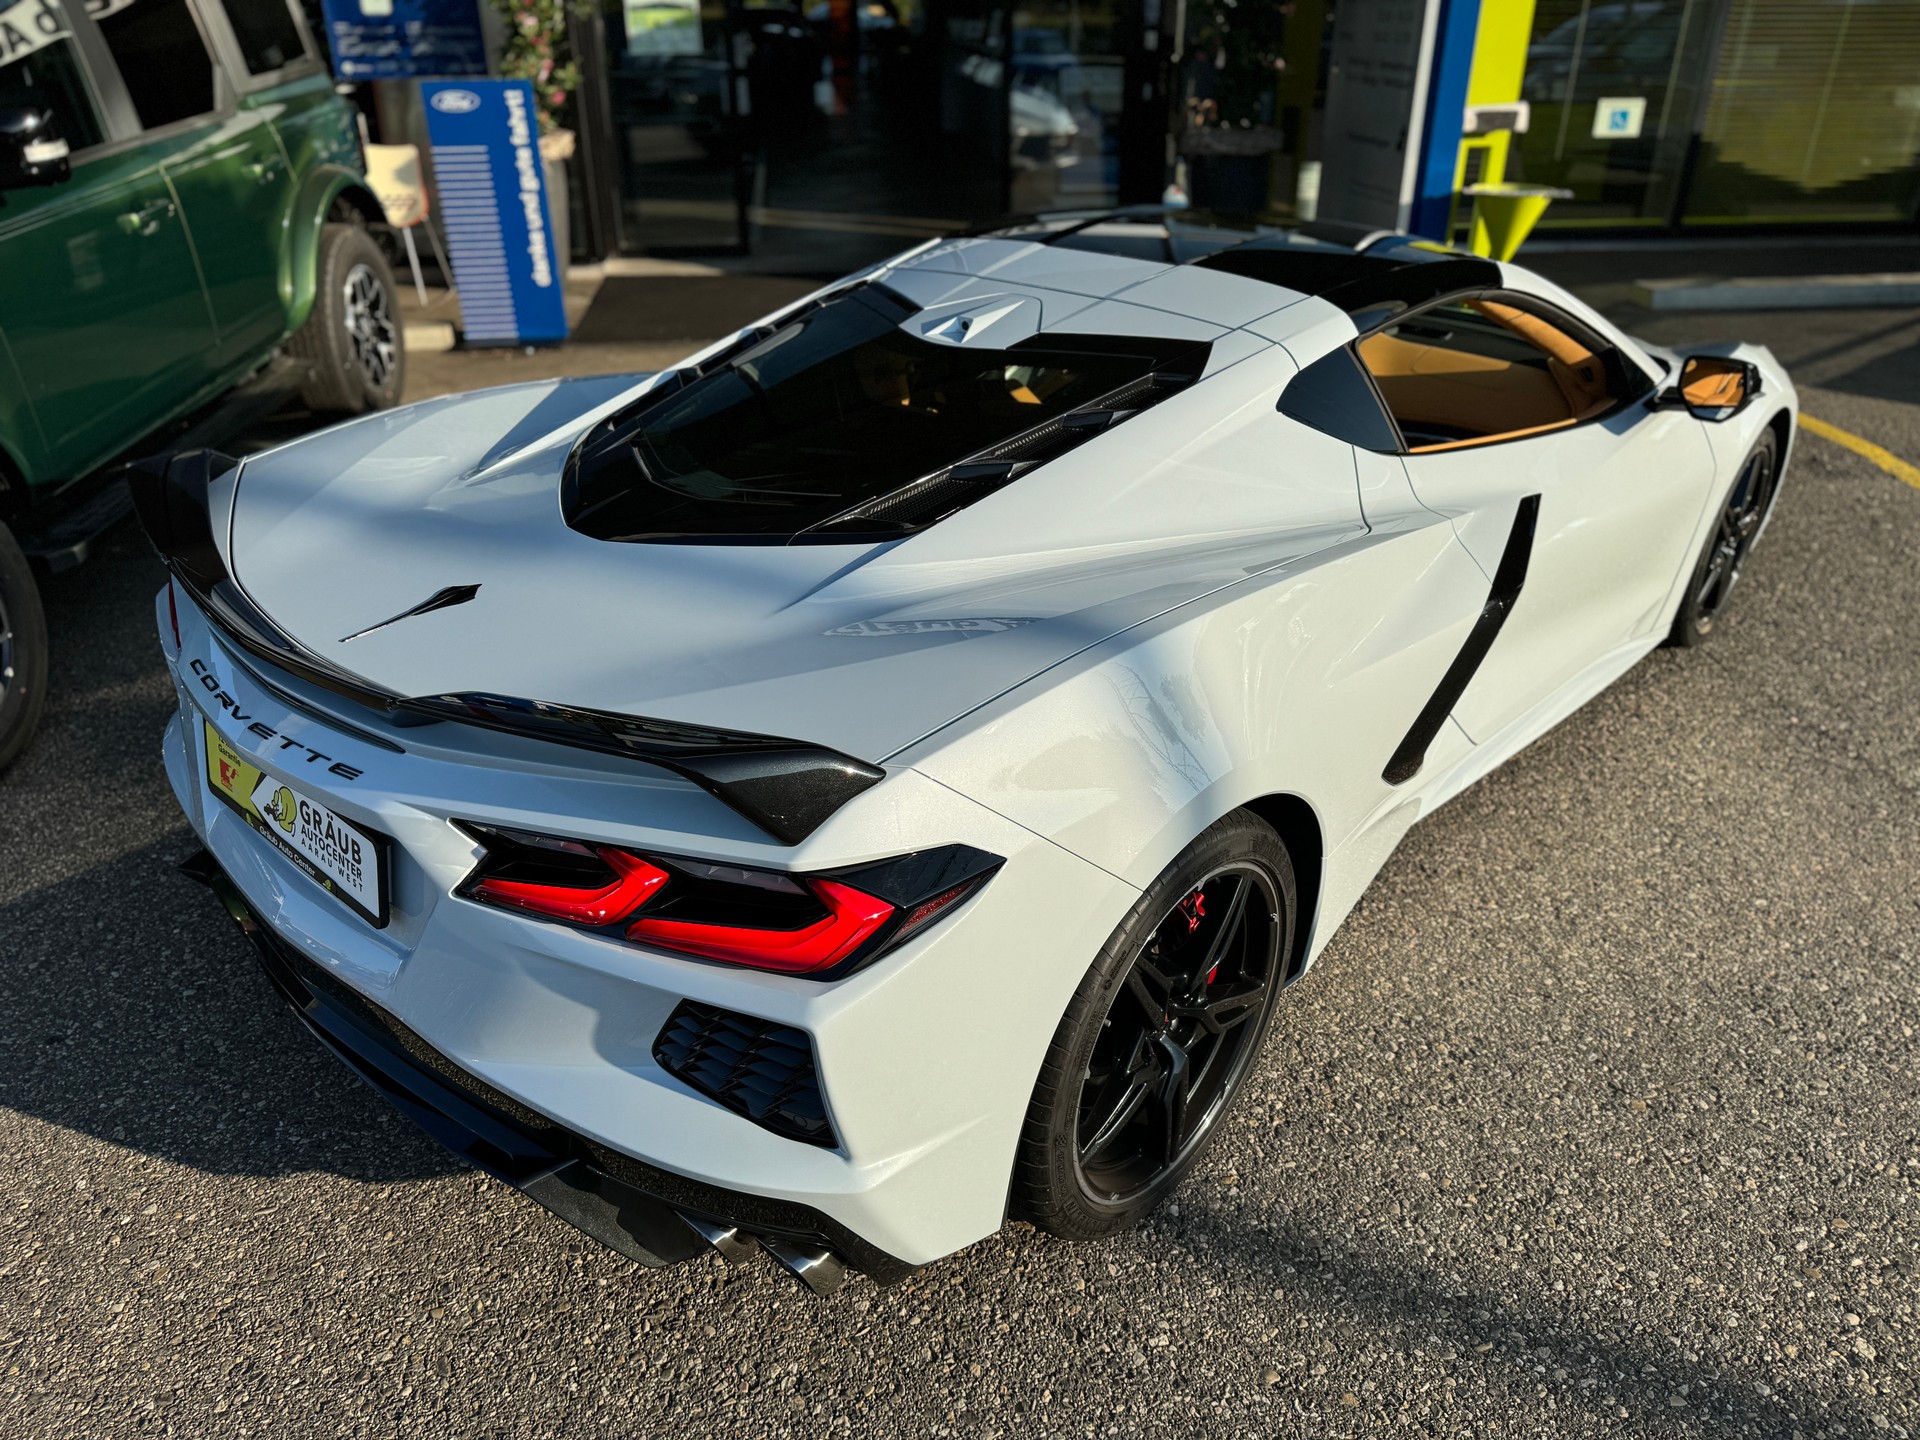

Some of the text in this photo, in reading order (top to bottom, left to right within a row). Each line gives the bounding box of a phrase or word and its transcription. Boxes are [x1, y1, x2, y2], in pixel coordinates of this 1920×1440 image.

[190, 658, 364, 781] CORVETTE
[217, 743, 242, 768] Garantie
[259, 825, 316, 877] Gräub Auto Center
[300, 800, 362, 866] GRÄUB
[301, 824, 363, 882] AUTOCENTER
[301, 838, 363, 893] AARAU WEST
